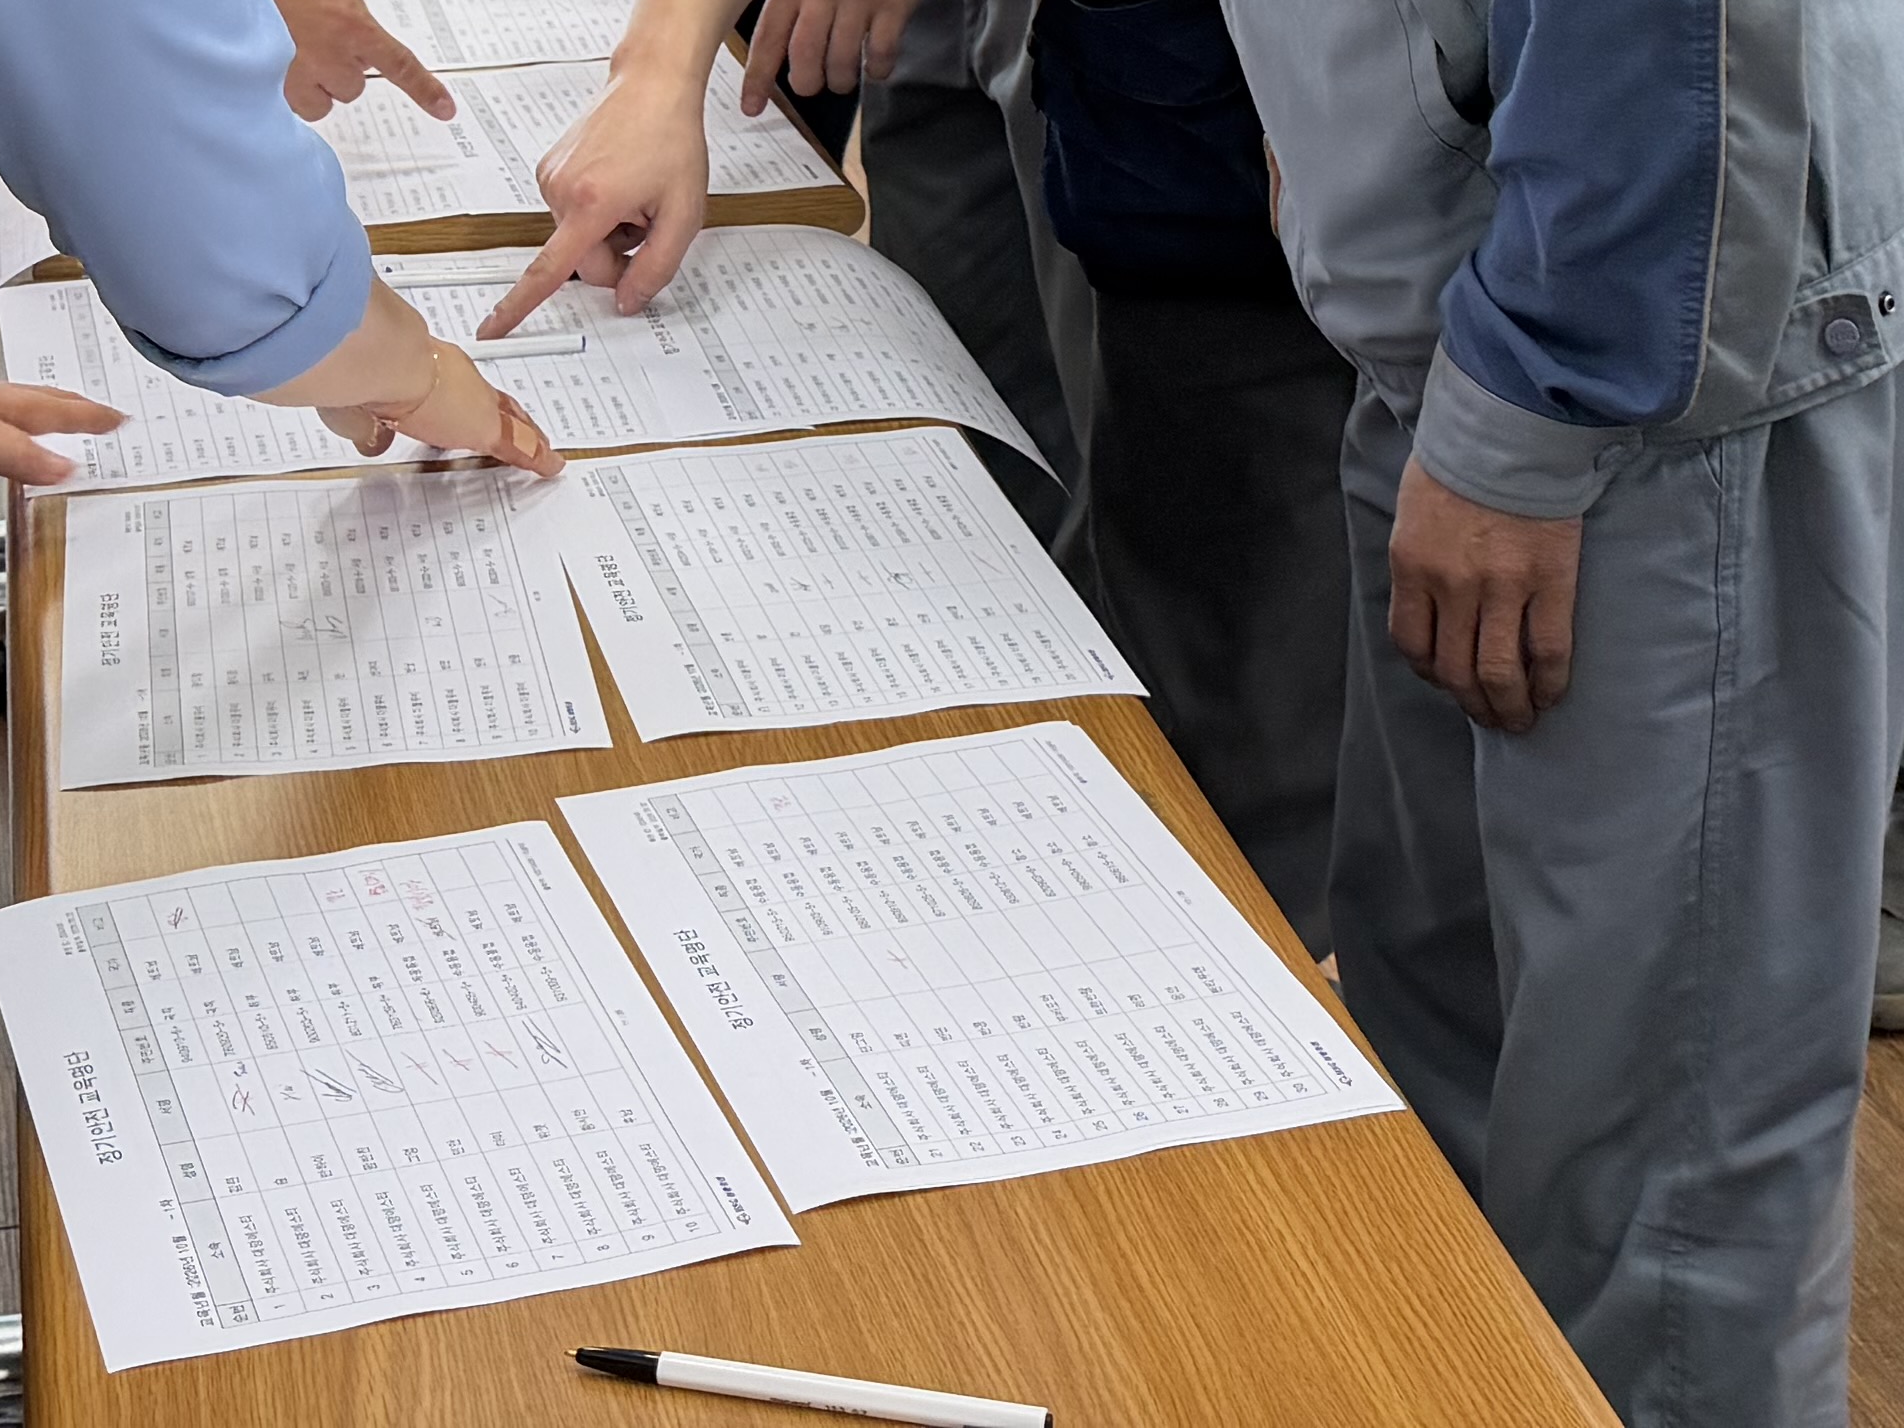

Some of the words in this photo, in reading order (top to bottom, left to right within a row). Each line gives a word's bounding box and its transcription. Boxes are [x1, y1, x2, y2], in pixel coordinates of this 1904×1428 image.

[672, 928, 720, 978] 교육명단
[705, 980, 754, 1030] 정기안전
[63, 1049, 101, 1104] 교육명단
[82, 1106, 123, 1165] 정기안전
